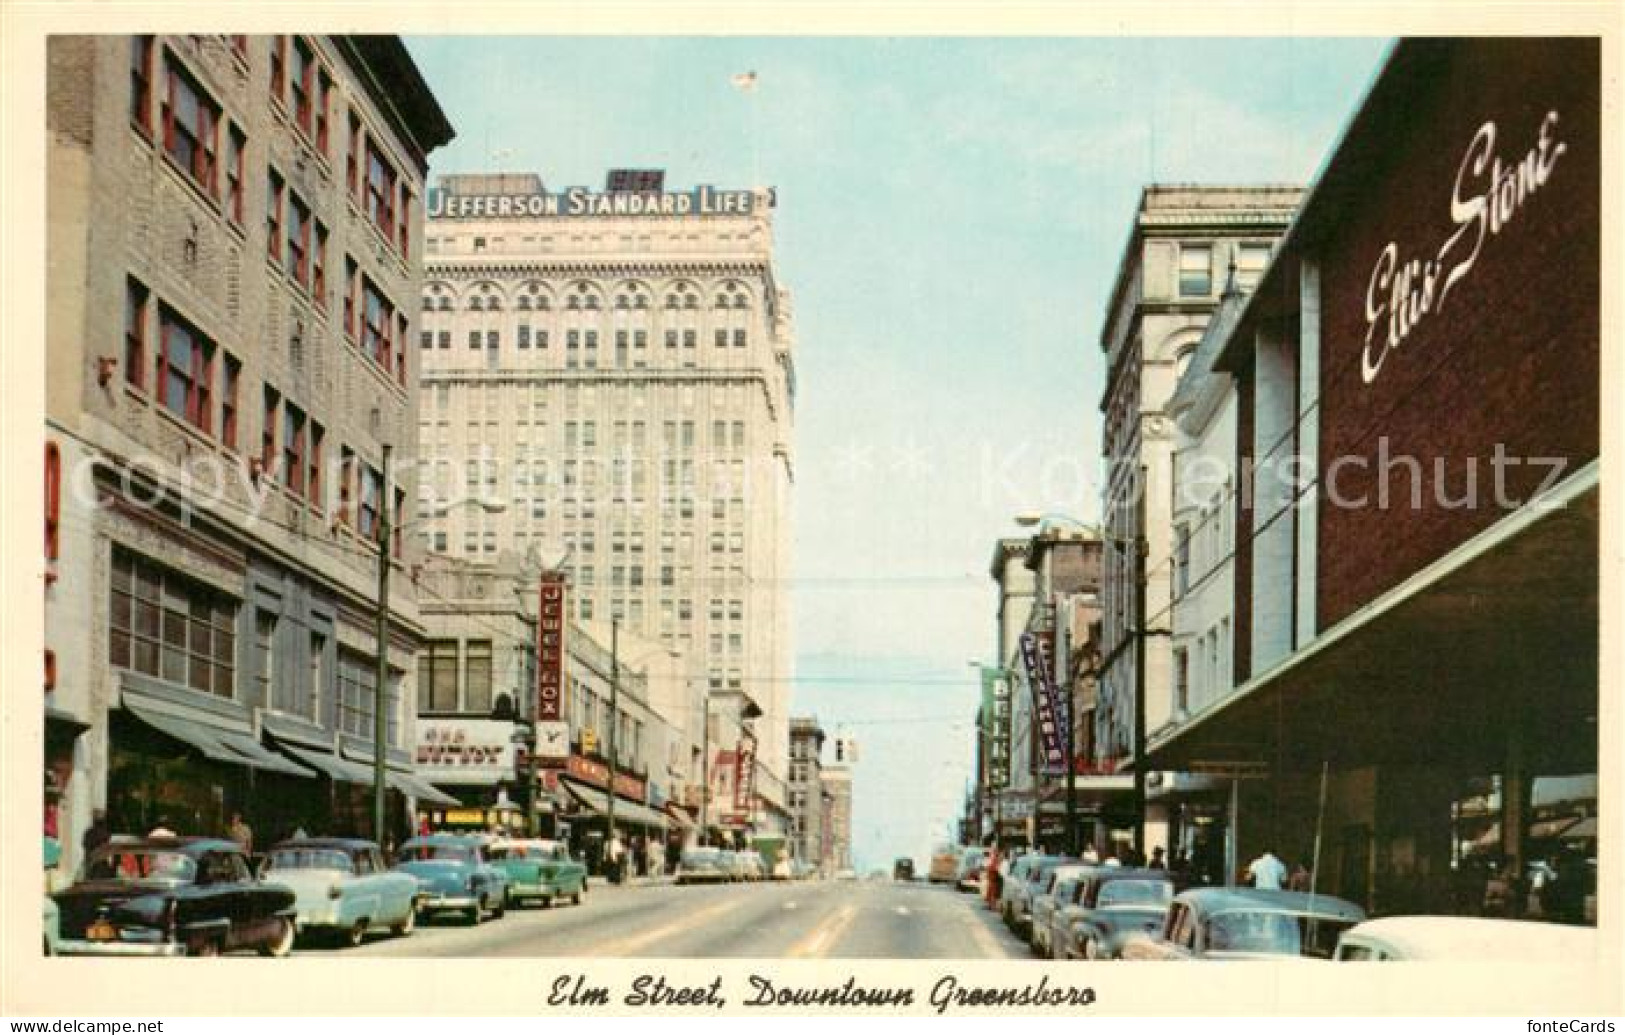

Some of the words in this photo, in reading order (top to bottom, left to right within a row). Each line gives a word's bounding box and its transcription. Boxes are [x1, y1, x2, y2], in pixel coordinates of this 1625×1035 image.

[429, 188, 558, 217] JEFFERSON
[567, 186, 692, 216] STANDARD
[700, 185, 750, 213] LIFE
[1360, 241, 1440, 384] Ellis
[1437, 110, 1568, 314] Stone
[540, 672, 559, 716] BOX
